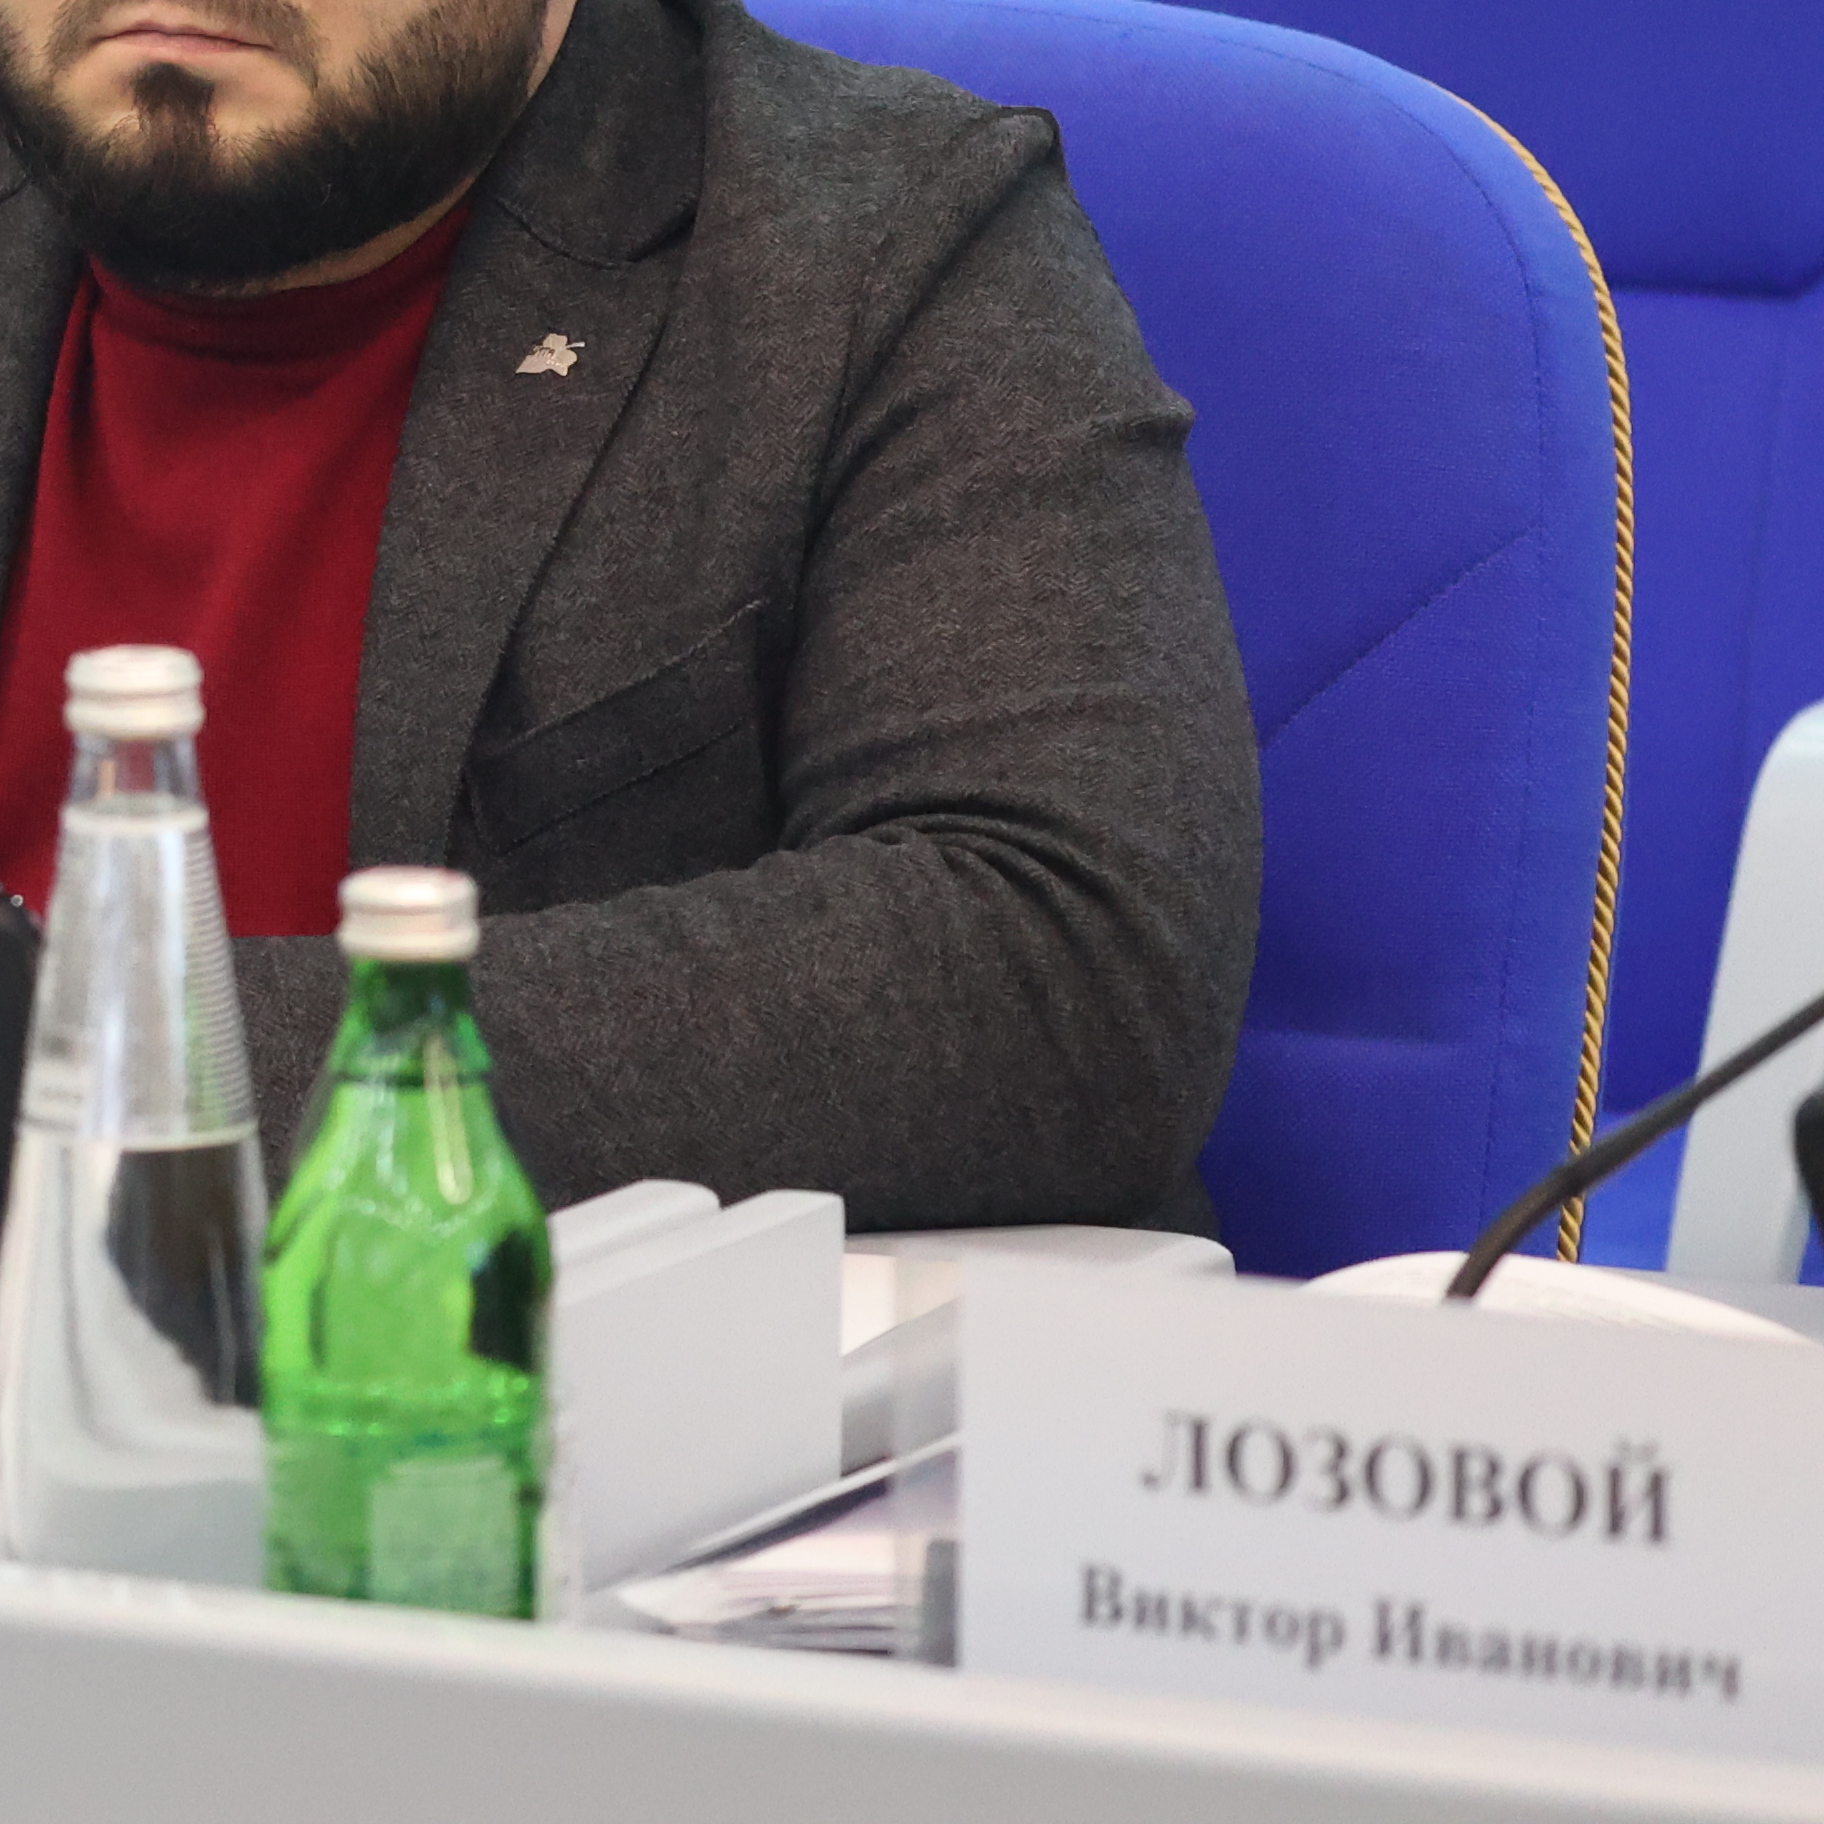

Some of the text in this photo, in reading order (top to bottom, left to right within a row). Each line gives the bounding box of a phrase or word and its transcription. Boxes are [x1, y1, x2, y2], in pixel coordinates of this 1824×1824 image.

[1142, 1410, 1673, 1544] ЛОЗОВОЙ
[1080, 1564, 1740, 1702] Виктор Иванович
